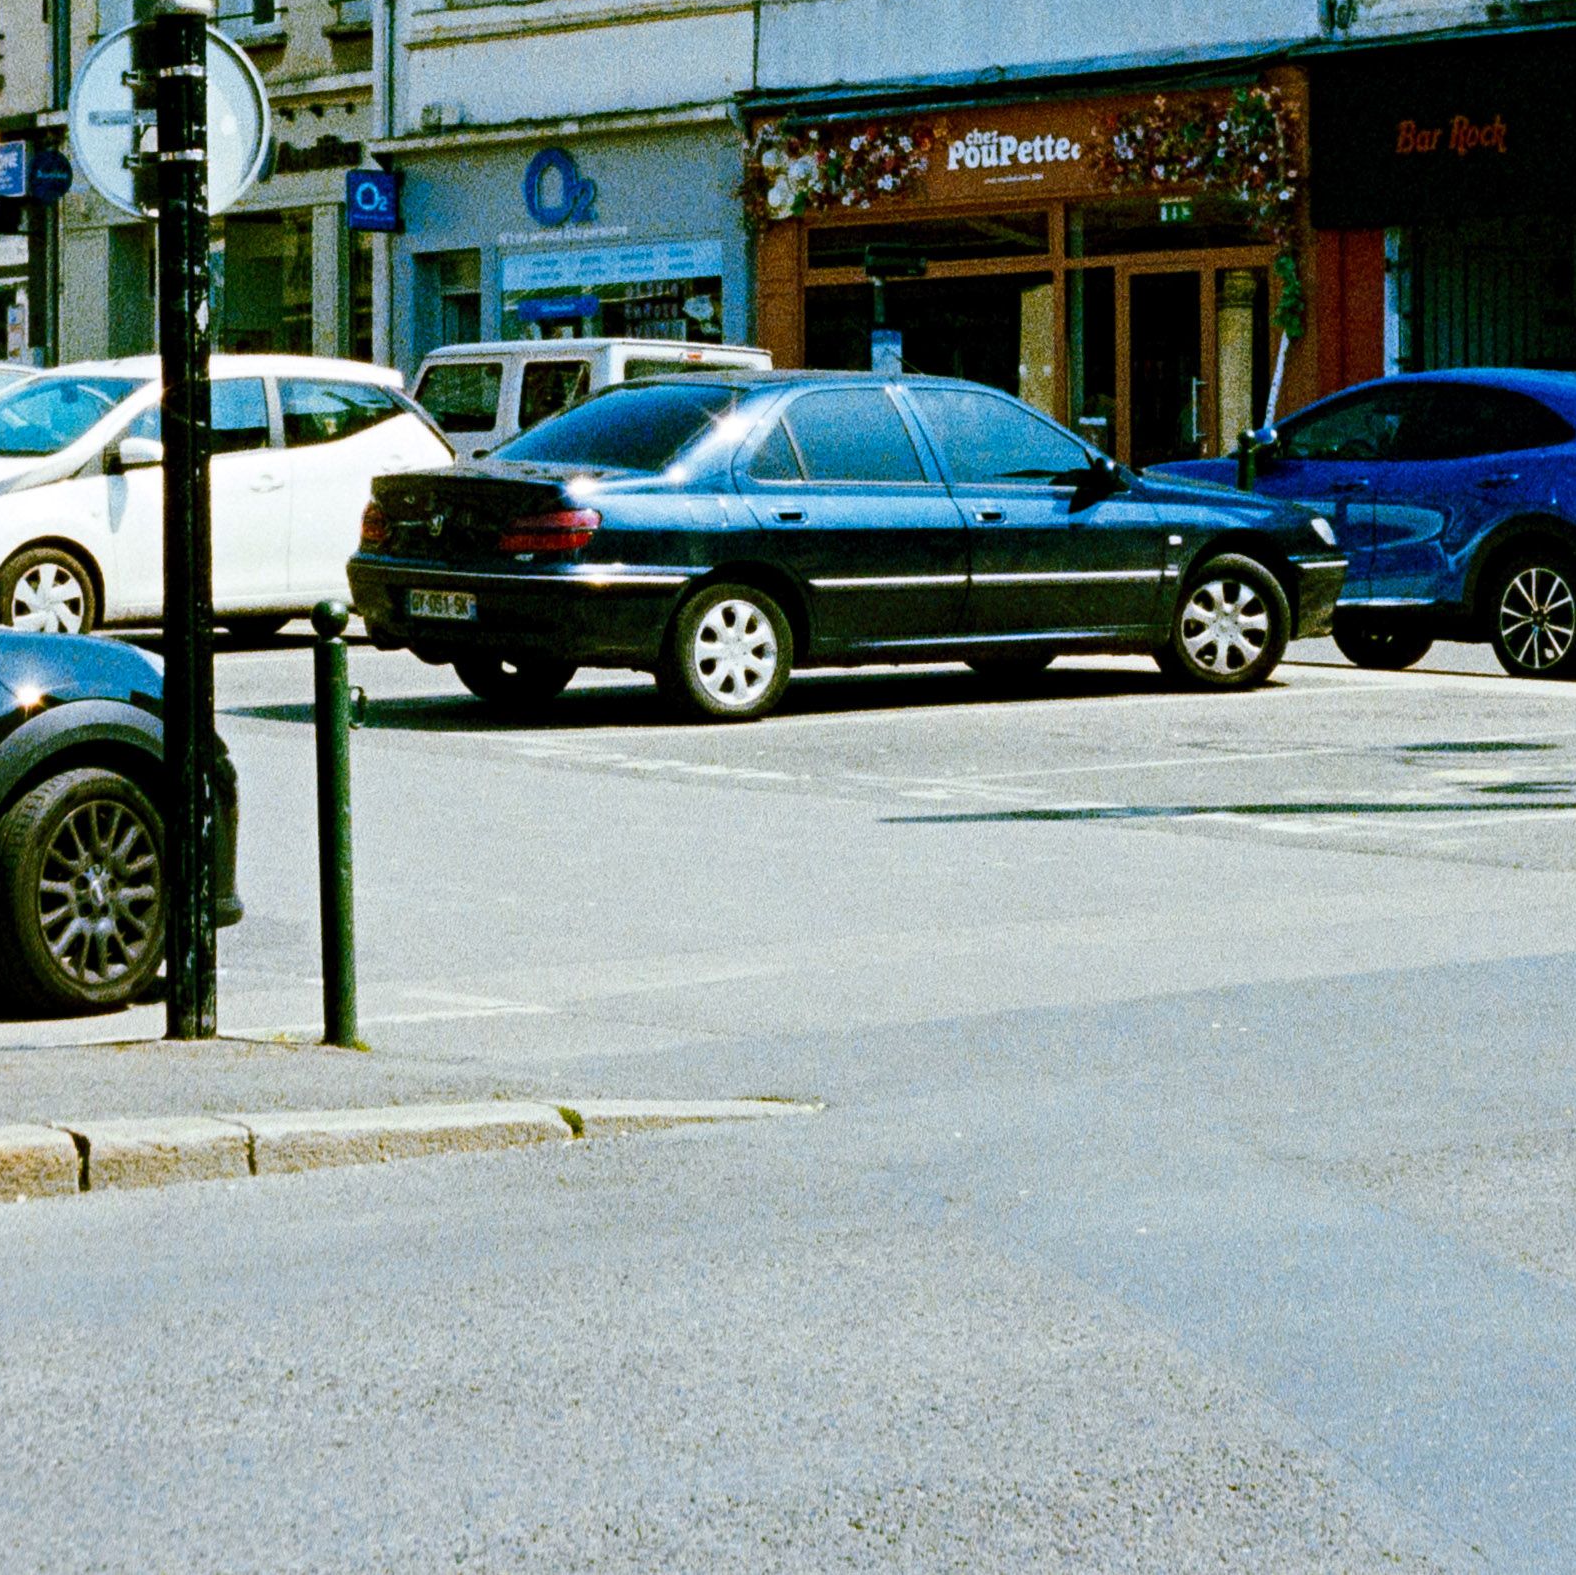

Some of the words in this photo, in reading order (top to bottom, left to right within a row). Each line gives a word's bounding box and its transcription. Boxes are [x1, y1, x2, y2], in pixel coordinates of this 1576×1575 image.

[965, 128, 1000, 145] chez
[1395, 119, 1442, 153] Bar
[1448, 114, 1507, 156] Rock
